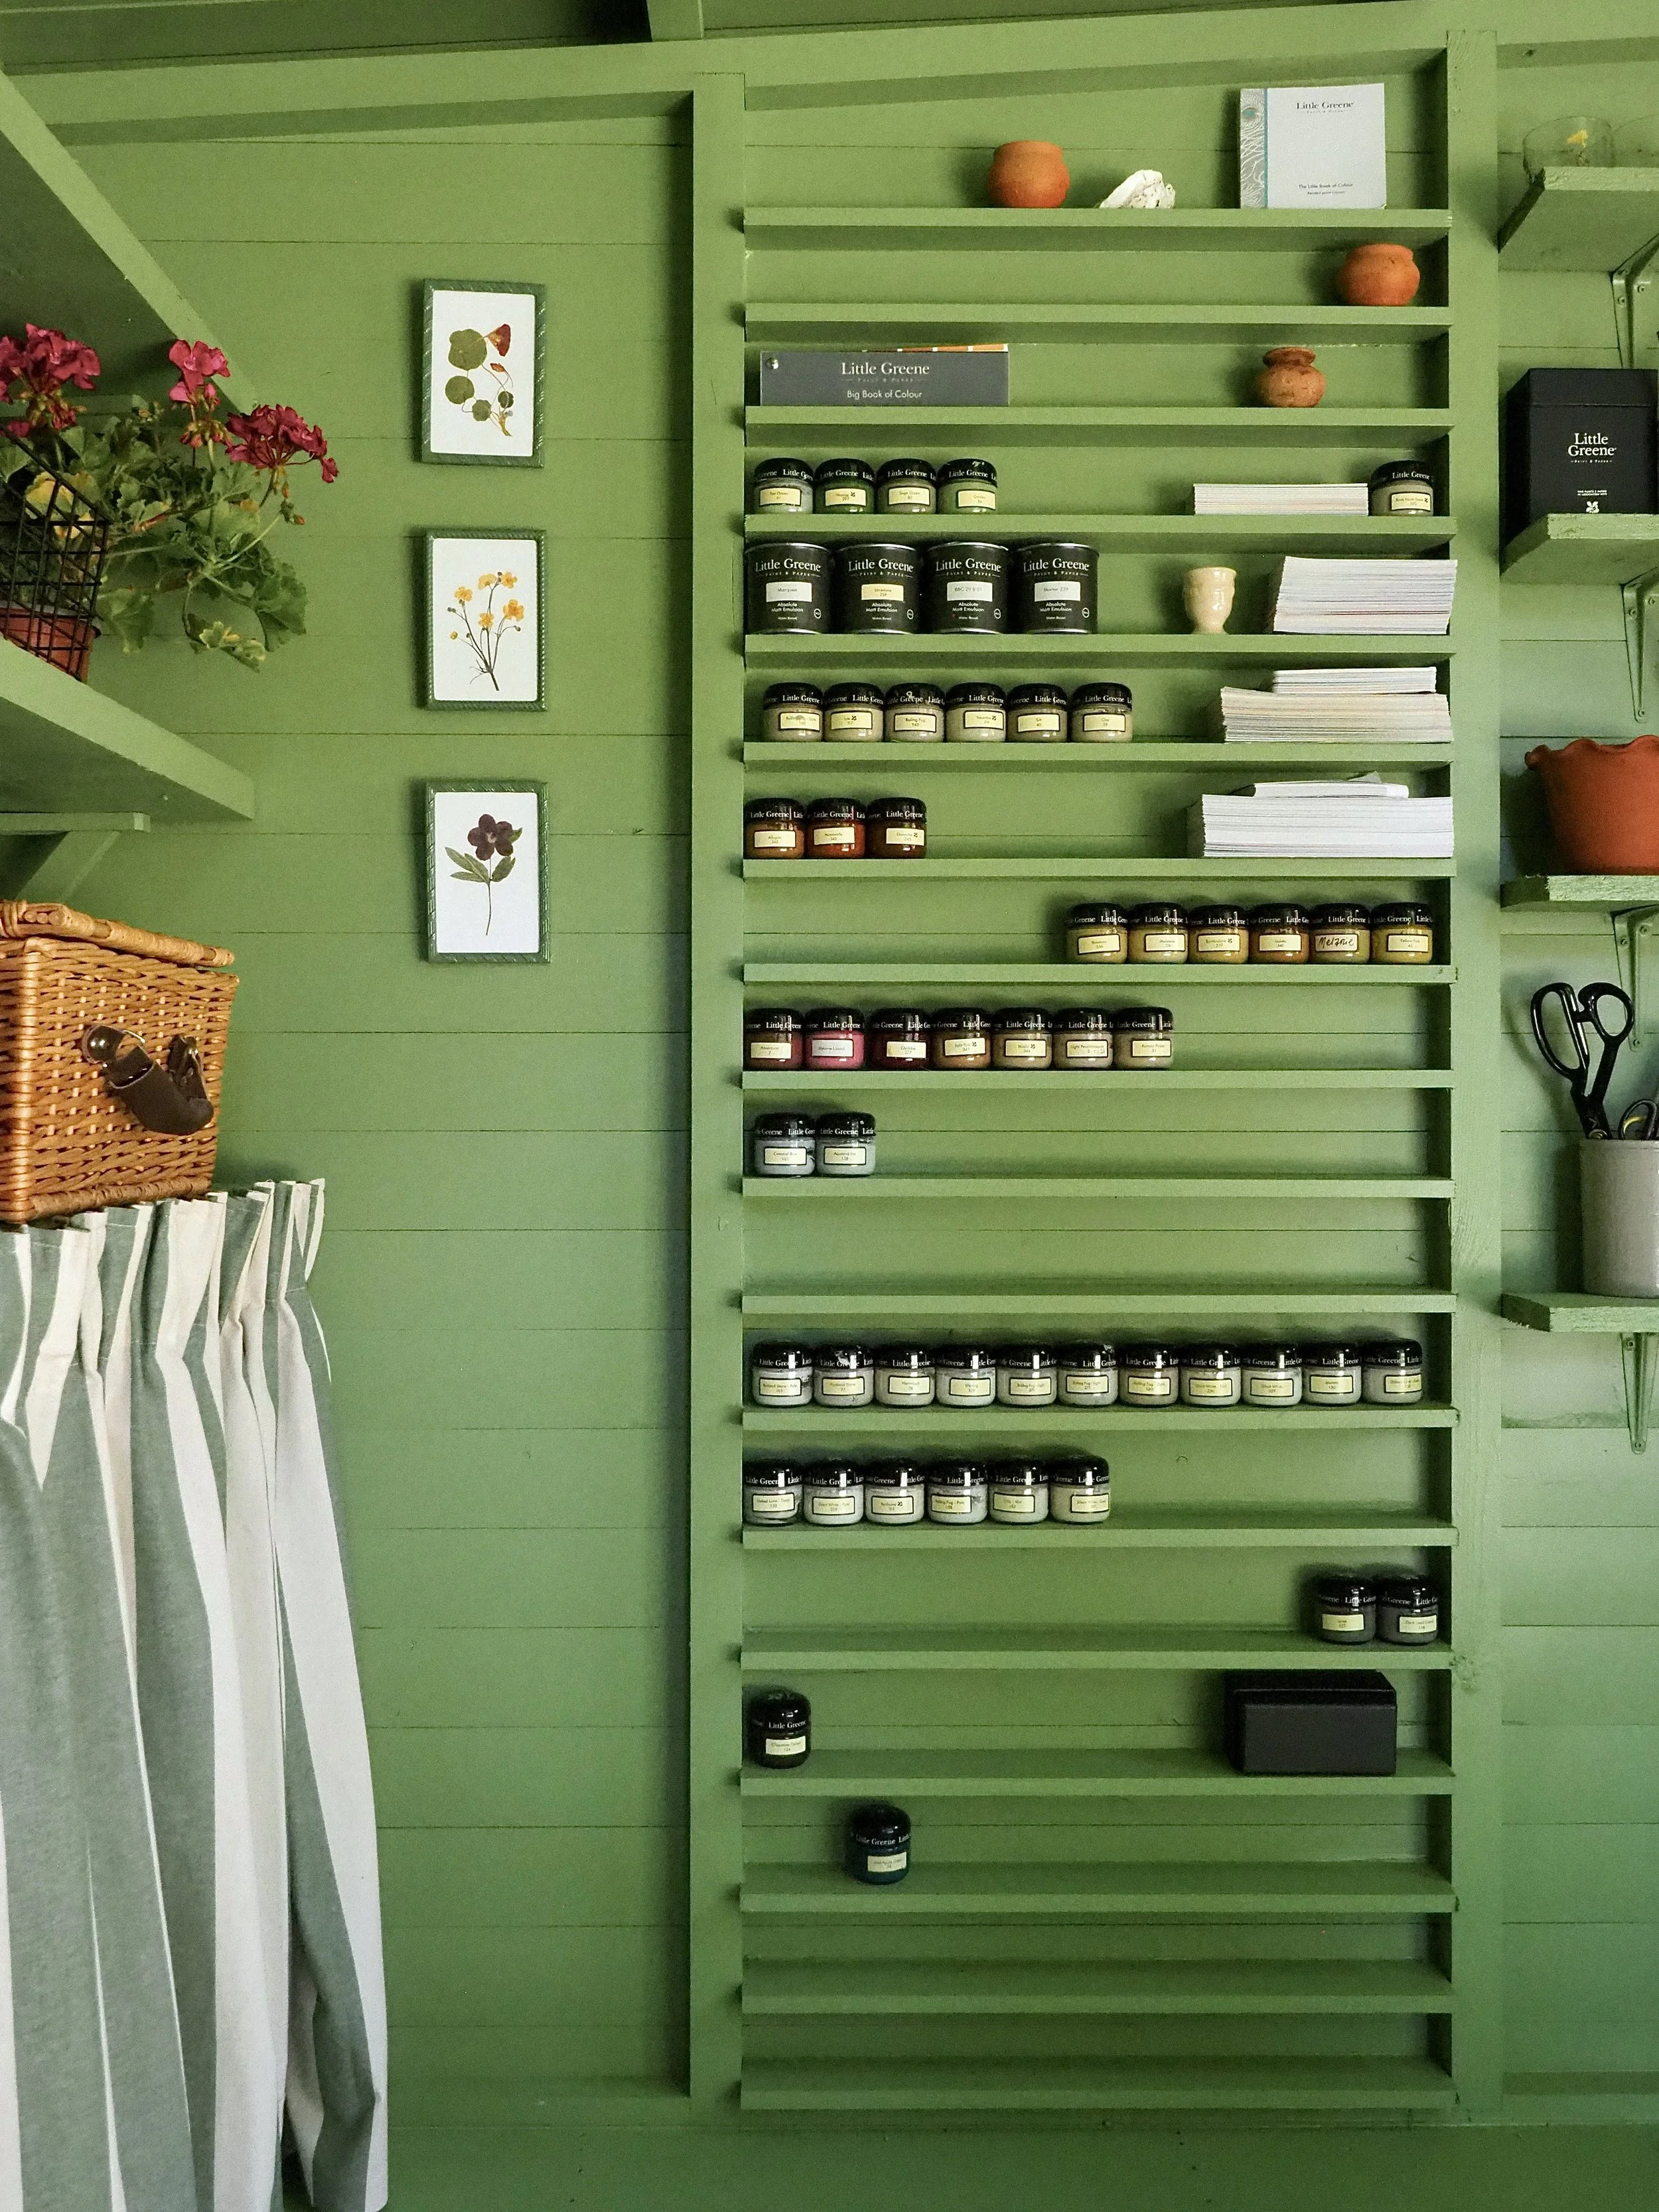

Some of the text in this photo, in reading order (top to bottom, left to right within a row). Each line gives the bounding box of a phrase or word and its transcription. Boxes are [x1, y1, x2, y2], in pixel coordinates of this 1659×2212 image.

[842, 362, 929, 374] Little Greene
[847, 390, 859, 400] Big
[1574, 433, 1608, 445] Little
[1568, 445, 1615, 456] Greene
[1411, 471, 1429, 480] Greene
[755, 559, 821, 572] Little Greene
[849, 559, 913, 573] Little Greene
[936, 558, 1001, 572] Little Greene
[1024, 558, 1090, 572] Little Greene
[1319, 935, 1354, 949] Melanie
